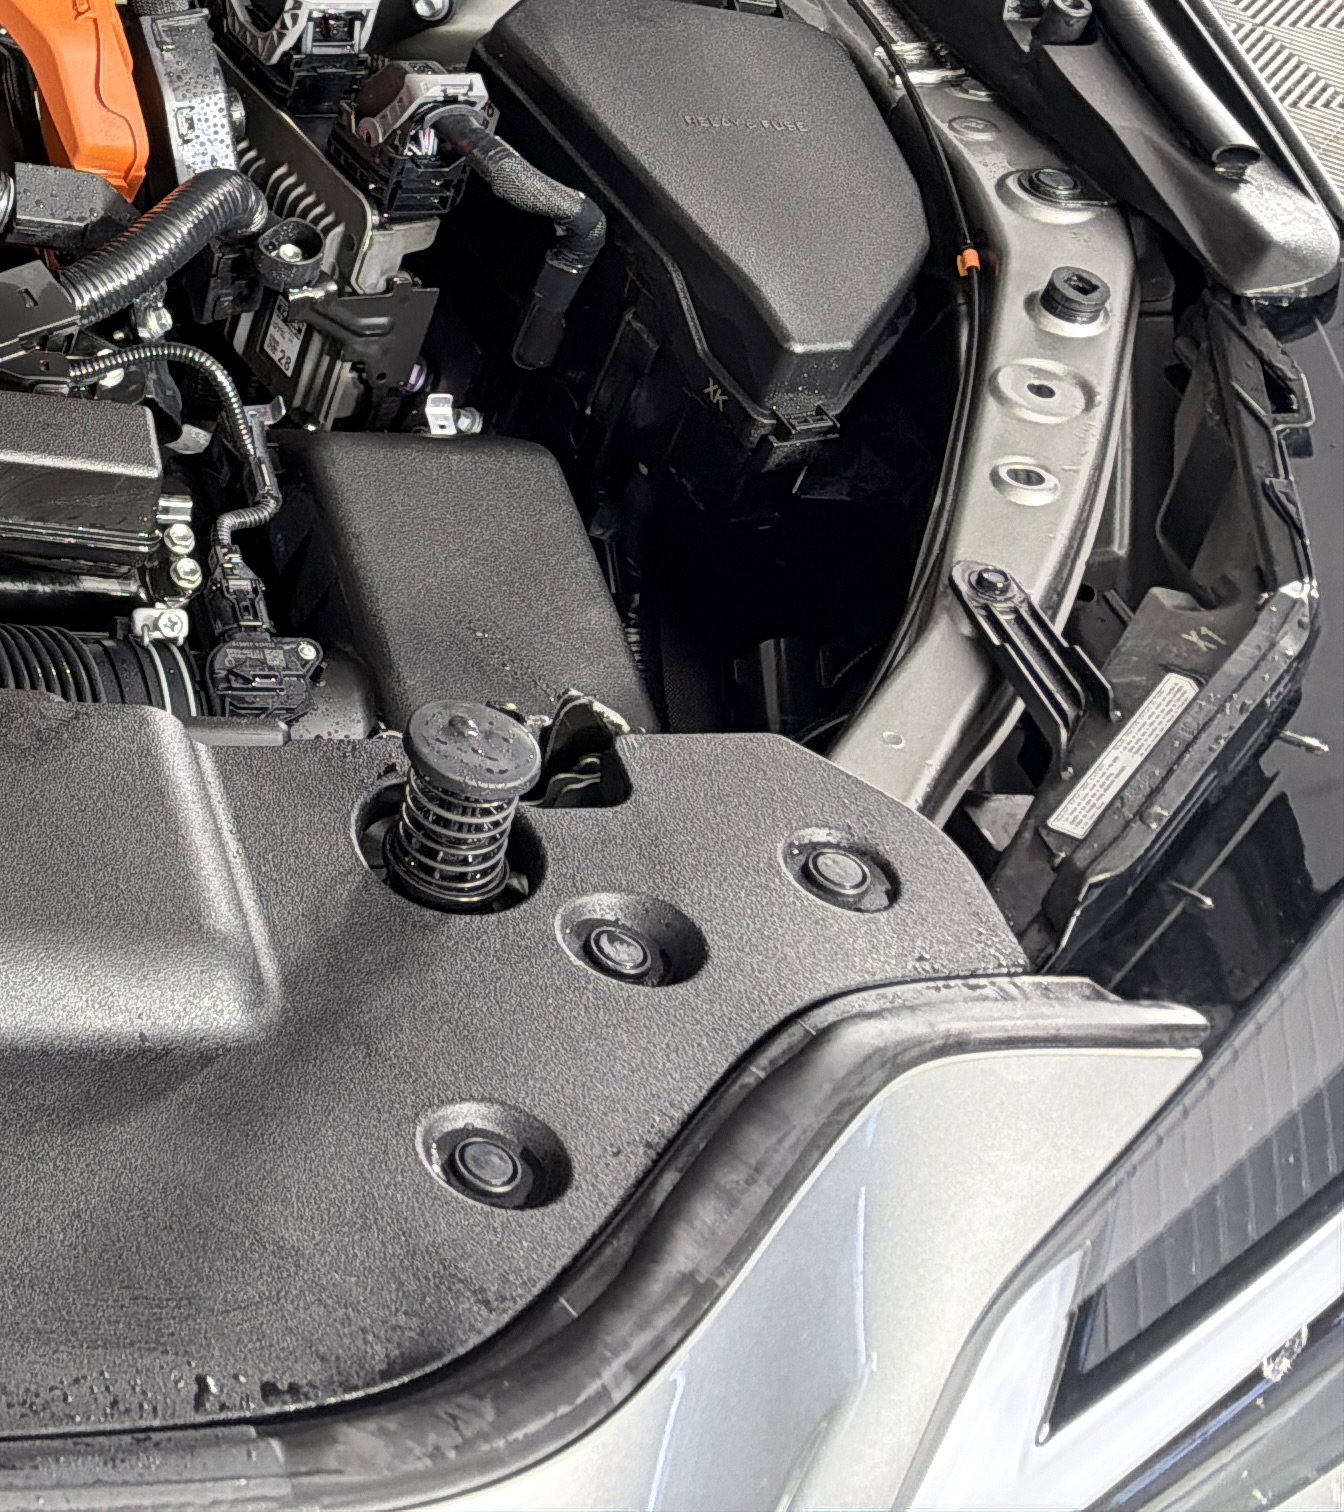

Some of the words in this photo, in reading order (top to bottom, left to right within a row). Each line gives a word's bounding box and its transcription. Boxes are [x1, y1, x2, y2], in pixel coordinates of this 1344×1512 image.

[683, 114, 739, 129] RELAY
[760, 119, 809, 132] FUSE
[277, 348, 292, 372] 28
[1180, 626, 1227, 652] X1
